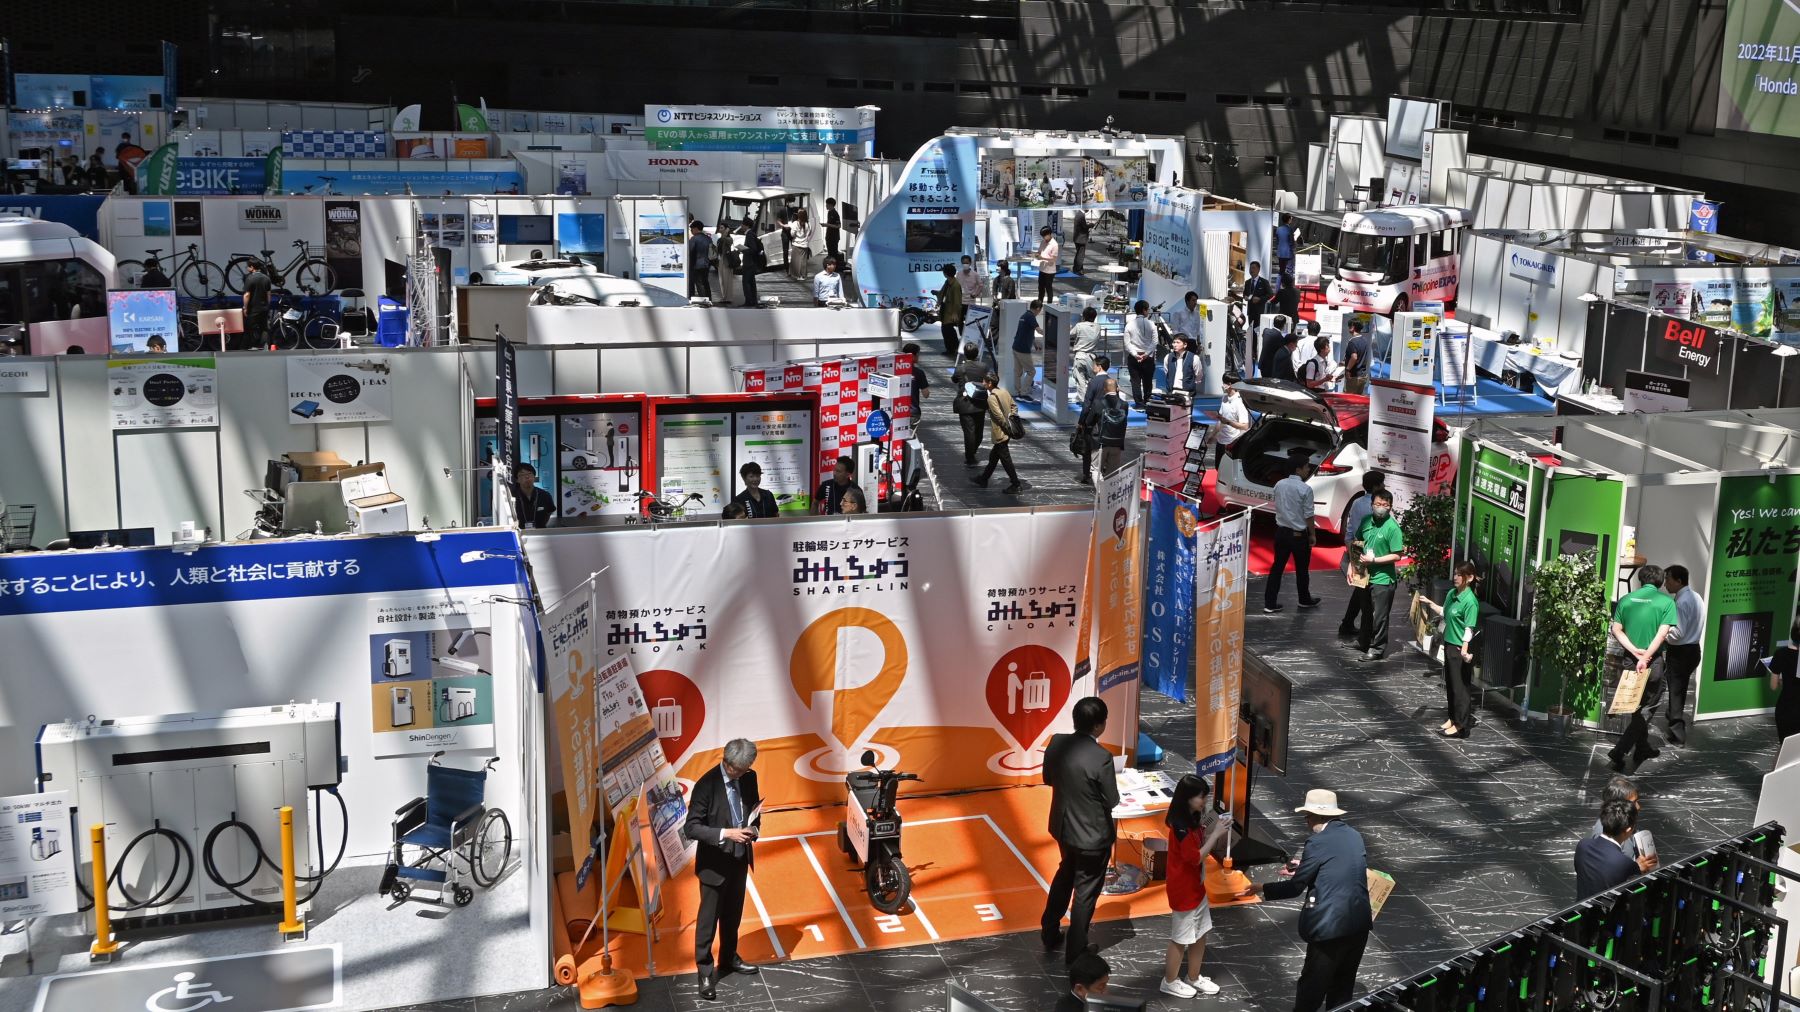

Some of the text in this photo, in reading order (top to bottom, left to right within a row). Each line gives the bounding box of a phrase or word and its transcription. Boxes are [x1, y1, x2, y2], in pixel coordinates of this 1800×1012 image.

[648, 158, 699, 167] HONDA
[909, 183, 958, 192] 移動でもっと
[909, 194, 957, 203] できることを
[245, 209, 282, 219] WONKA
[328, 210, 358, 219] WONKA
[1519, 257, 1556, 273] TOKAIGIKEN
[1411, 274, 1457, 294] Philippine EXPO
[1361, 290, 1378, 298] EXPO
[1664, 320, 1706, 349] Bell
[1679, 346, 1711, 368] Energy
[896, 359, 911, 370] NITO
[785, 371, 802, 382] NITO
[823, 367, 840, 379] NITO
[747, 375, 763, 386] NITO
[840, 387, 858, 399] NITO
[894, 402, 910, 414] NITO
[821, 411, 838, 423] NITO
[840, 431, 856, 442] NITO
[1230, 484, 1276, 502] 移動式EV急速
[1731, 507, 1800, 524] Yes! We can
[793, 536, 910, 553] 駐輪場シェアサービス
[793, 553, 909, 583] みんちゅう
[1154, 550, 1166, 596] 株式会社
[793, 582, 908, 596] SHARE-LIN
[987, 585, 1077, 598] 荷物預かりサービス
[606, 605, 707, 620] 荷物預かりサービス
[988, 597, 1076, 621] みんちゅう
[607, 619, 707, 646] みんちゅう
[987, 620, 1075, 632] CLOAK
[608, 642, 707, 656] CLOAK
[408, 732, 452, 742] ShinDengen
[973, 903, 1003, 922] 3
[873, 914, 906, 933] 2
[804, 924, 825, 942] 1
